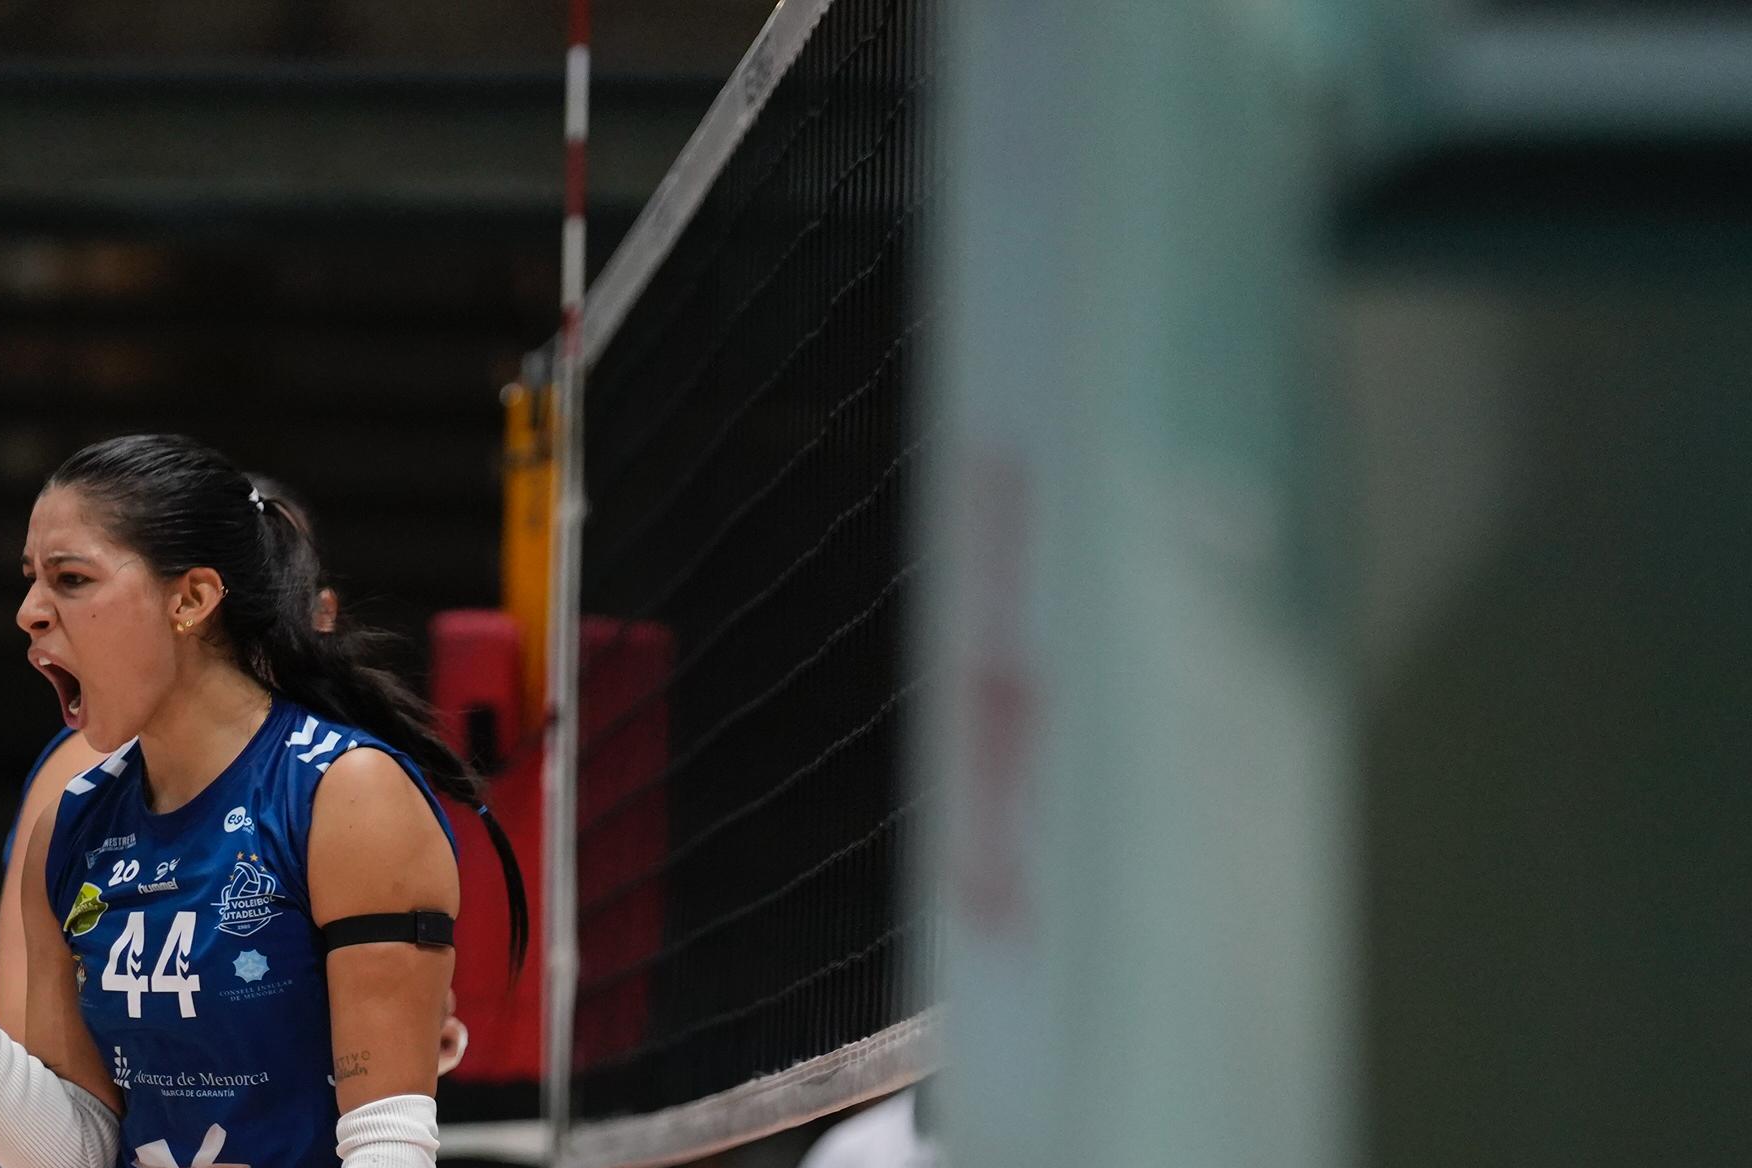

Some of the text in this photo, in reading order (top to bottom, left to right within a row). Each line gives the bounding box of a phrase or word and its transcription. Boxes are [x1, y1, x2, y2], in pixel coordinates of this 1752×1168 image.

[108, 859, 140, 887] 20
[137, 877, 179, 895] hummel
[101, 911, 201, 1019] 44
[177, 1071, 196, 1086] de
[199, 1071, 270, 1087] Menorca
[185, 1089, 195, 1097] DE
[195, 1088, 235, 1098] GARANTÍA
